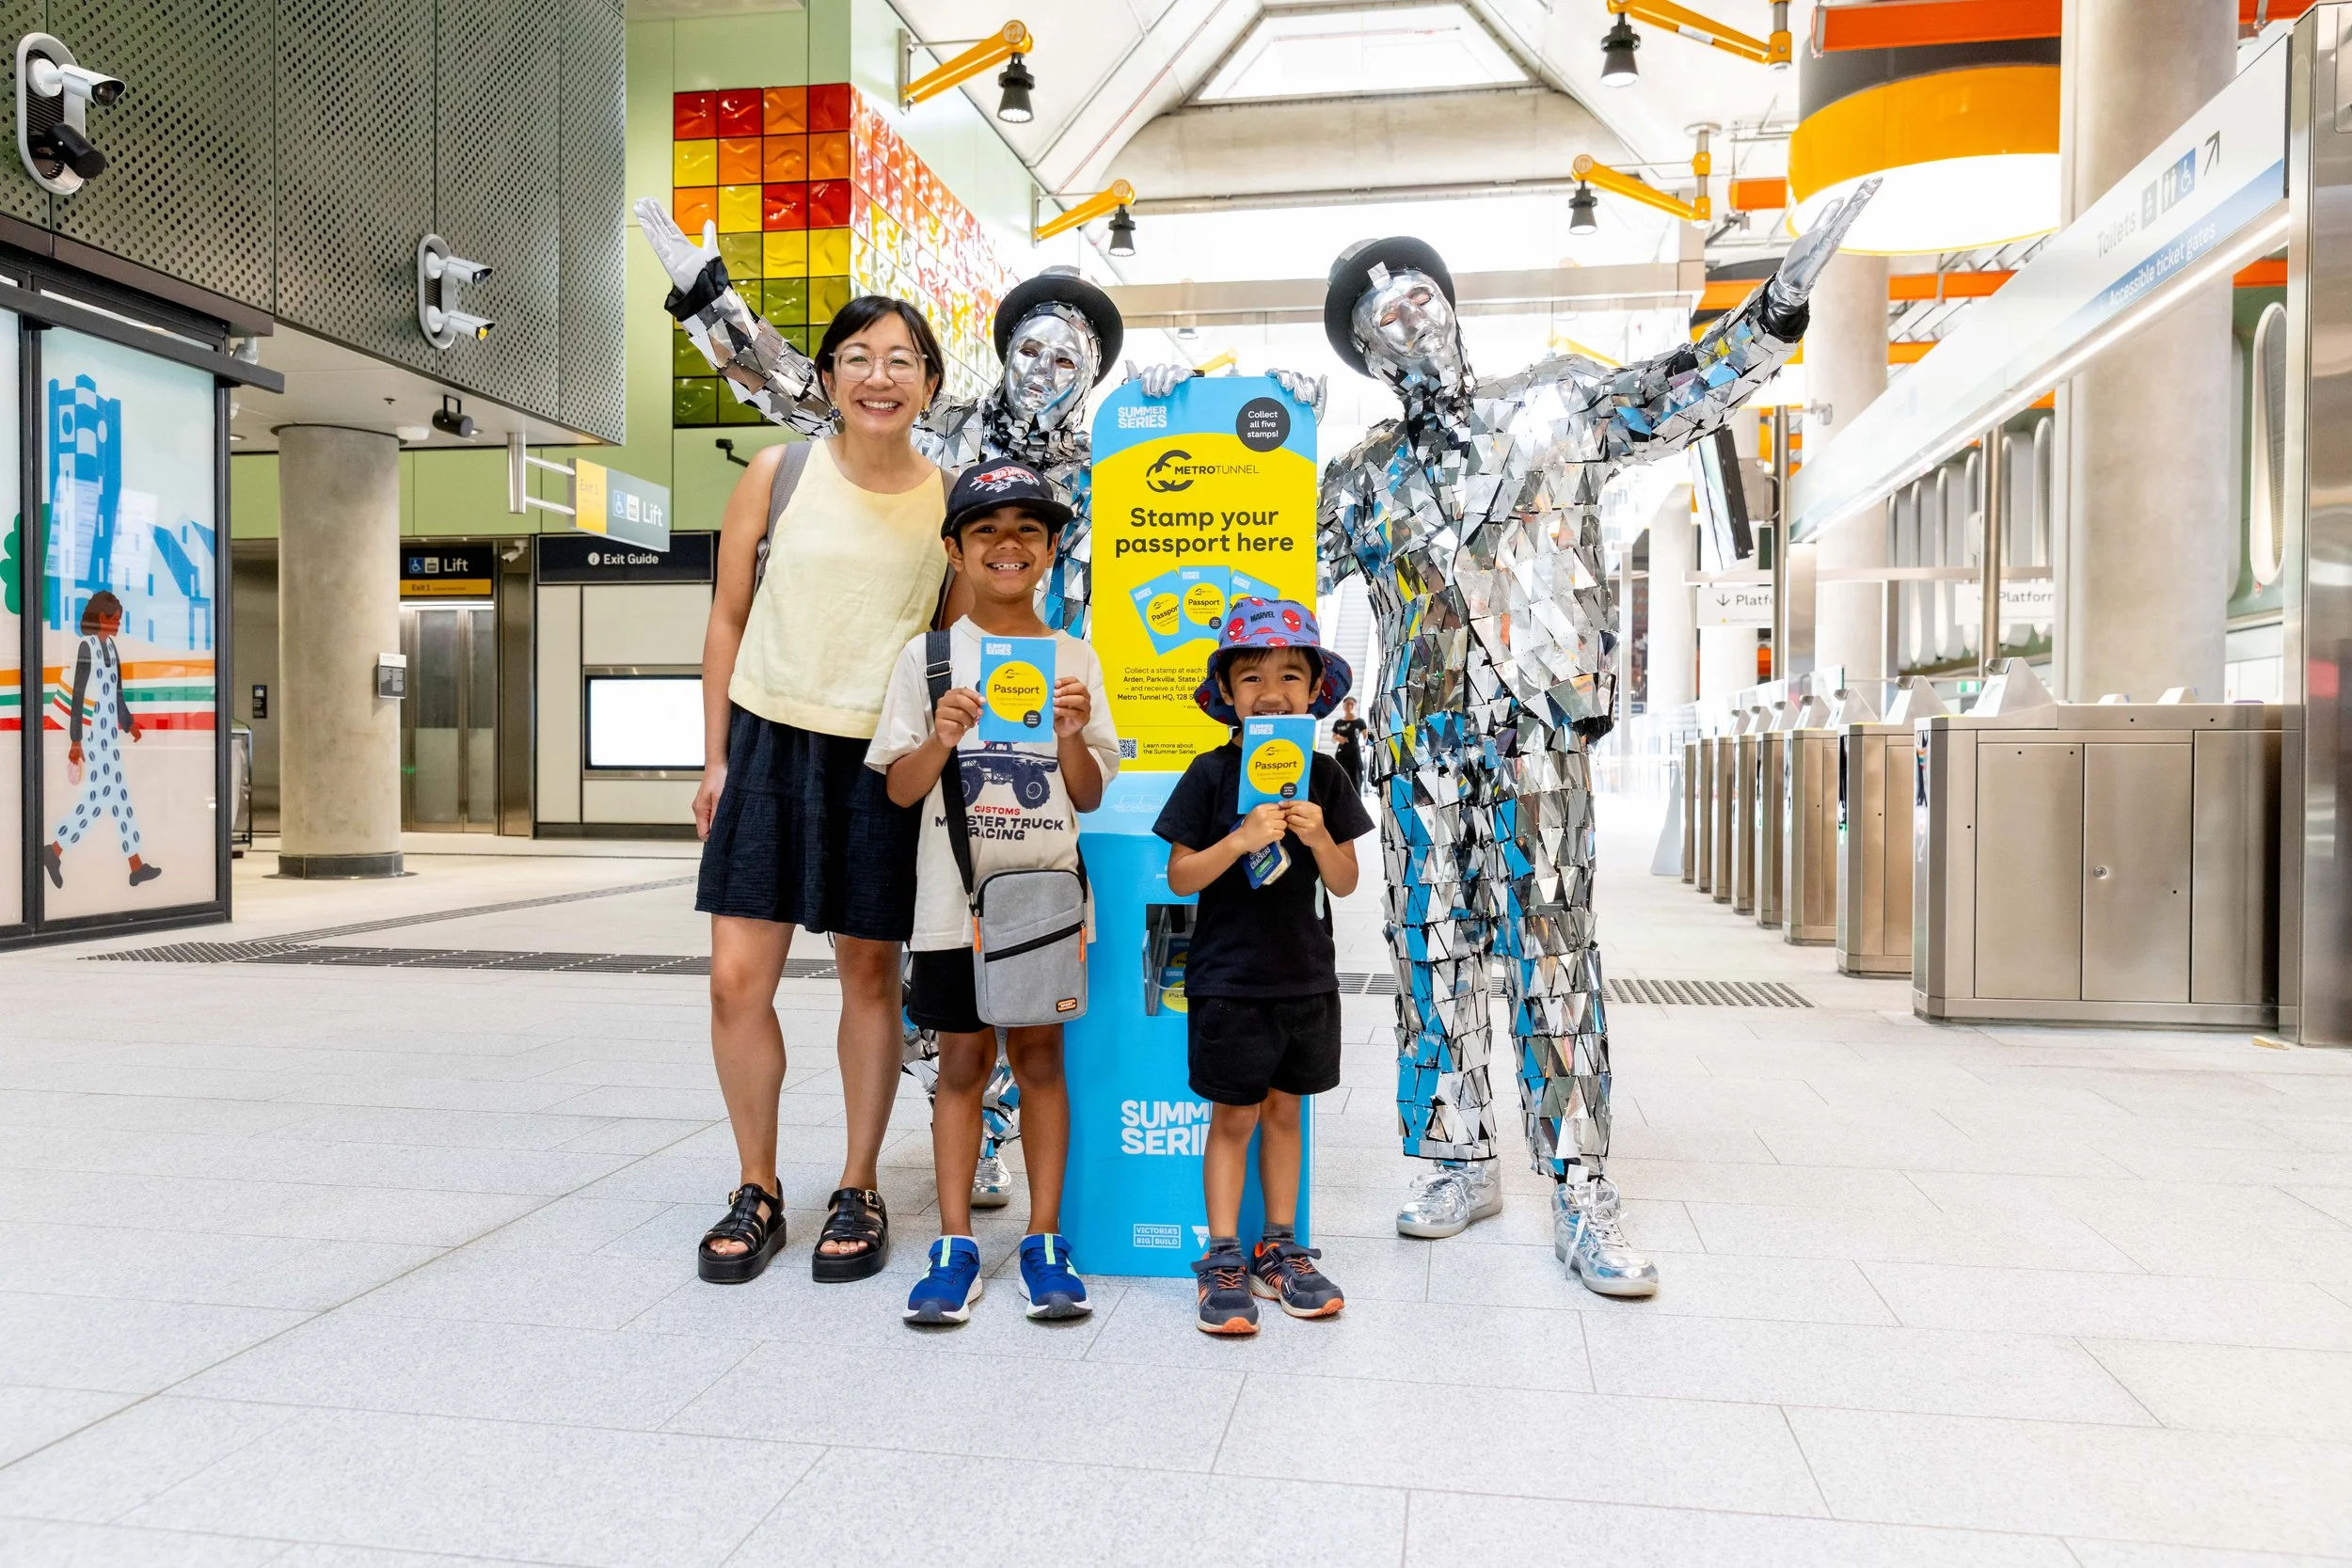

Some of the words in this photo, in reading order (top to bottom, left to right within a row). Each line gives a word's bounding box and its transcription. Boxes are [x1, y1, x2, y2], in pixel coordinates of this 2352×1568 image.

[2097, 212, 2137, 259] Toilets
[2107, 264, 2155, 308] Accessible
[2156, 243, 2185, 275] ticket
[2186, 221, 2217, 260] gates
[1118, 405, 1167, 419] SUMMER
[1248, 410, 1279, 419] Collect
[1118, 414, 1167, 429] SERIES
[1247, 430, 1279, 439] stamps!
[1174, 465, 1260, 475] METROTUNNEL
[643, 500, 663, 528] Lift
[1130, 507, 1215, 531] Stamp
[1221, 510, 1279, 531] your
[1115, 533, 1230, 558] passport
[1237, 532, 1295, 552] here
[443, 558, 469, 572] Lift
[603, 553, 626, 564] Exit
[627, 553, 659, 564] Guide
[1188, 598, 1220, 607] Passport
[1151, 604, 1179, 622] Passpor
[1250, 610, 1276, 623] MARVEL
[993, 684, 1040, 696] Passport
[1255, 760, 1297, 770] Passport
[935, 815, 1007, 828] MSTER
[1010, 817, 1064, 831] TRUCK
[1120, 1100, 1213, 1130] SUMM
[1120, 1124, 1209, 1155] SERI
[1136, 1227, 1178, 1236] VICTORIA'S
[1136, 1237, 1151, 1245] BIG
